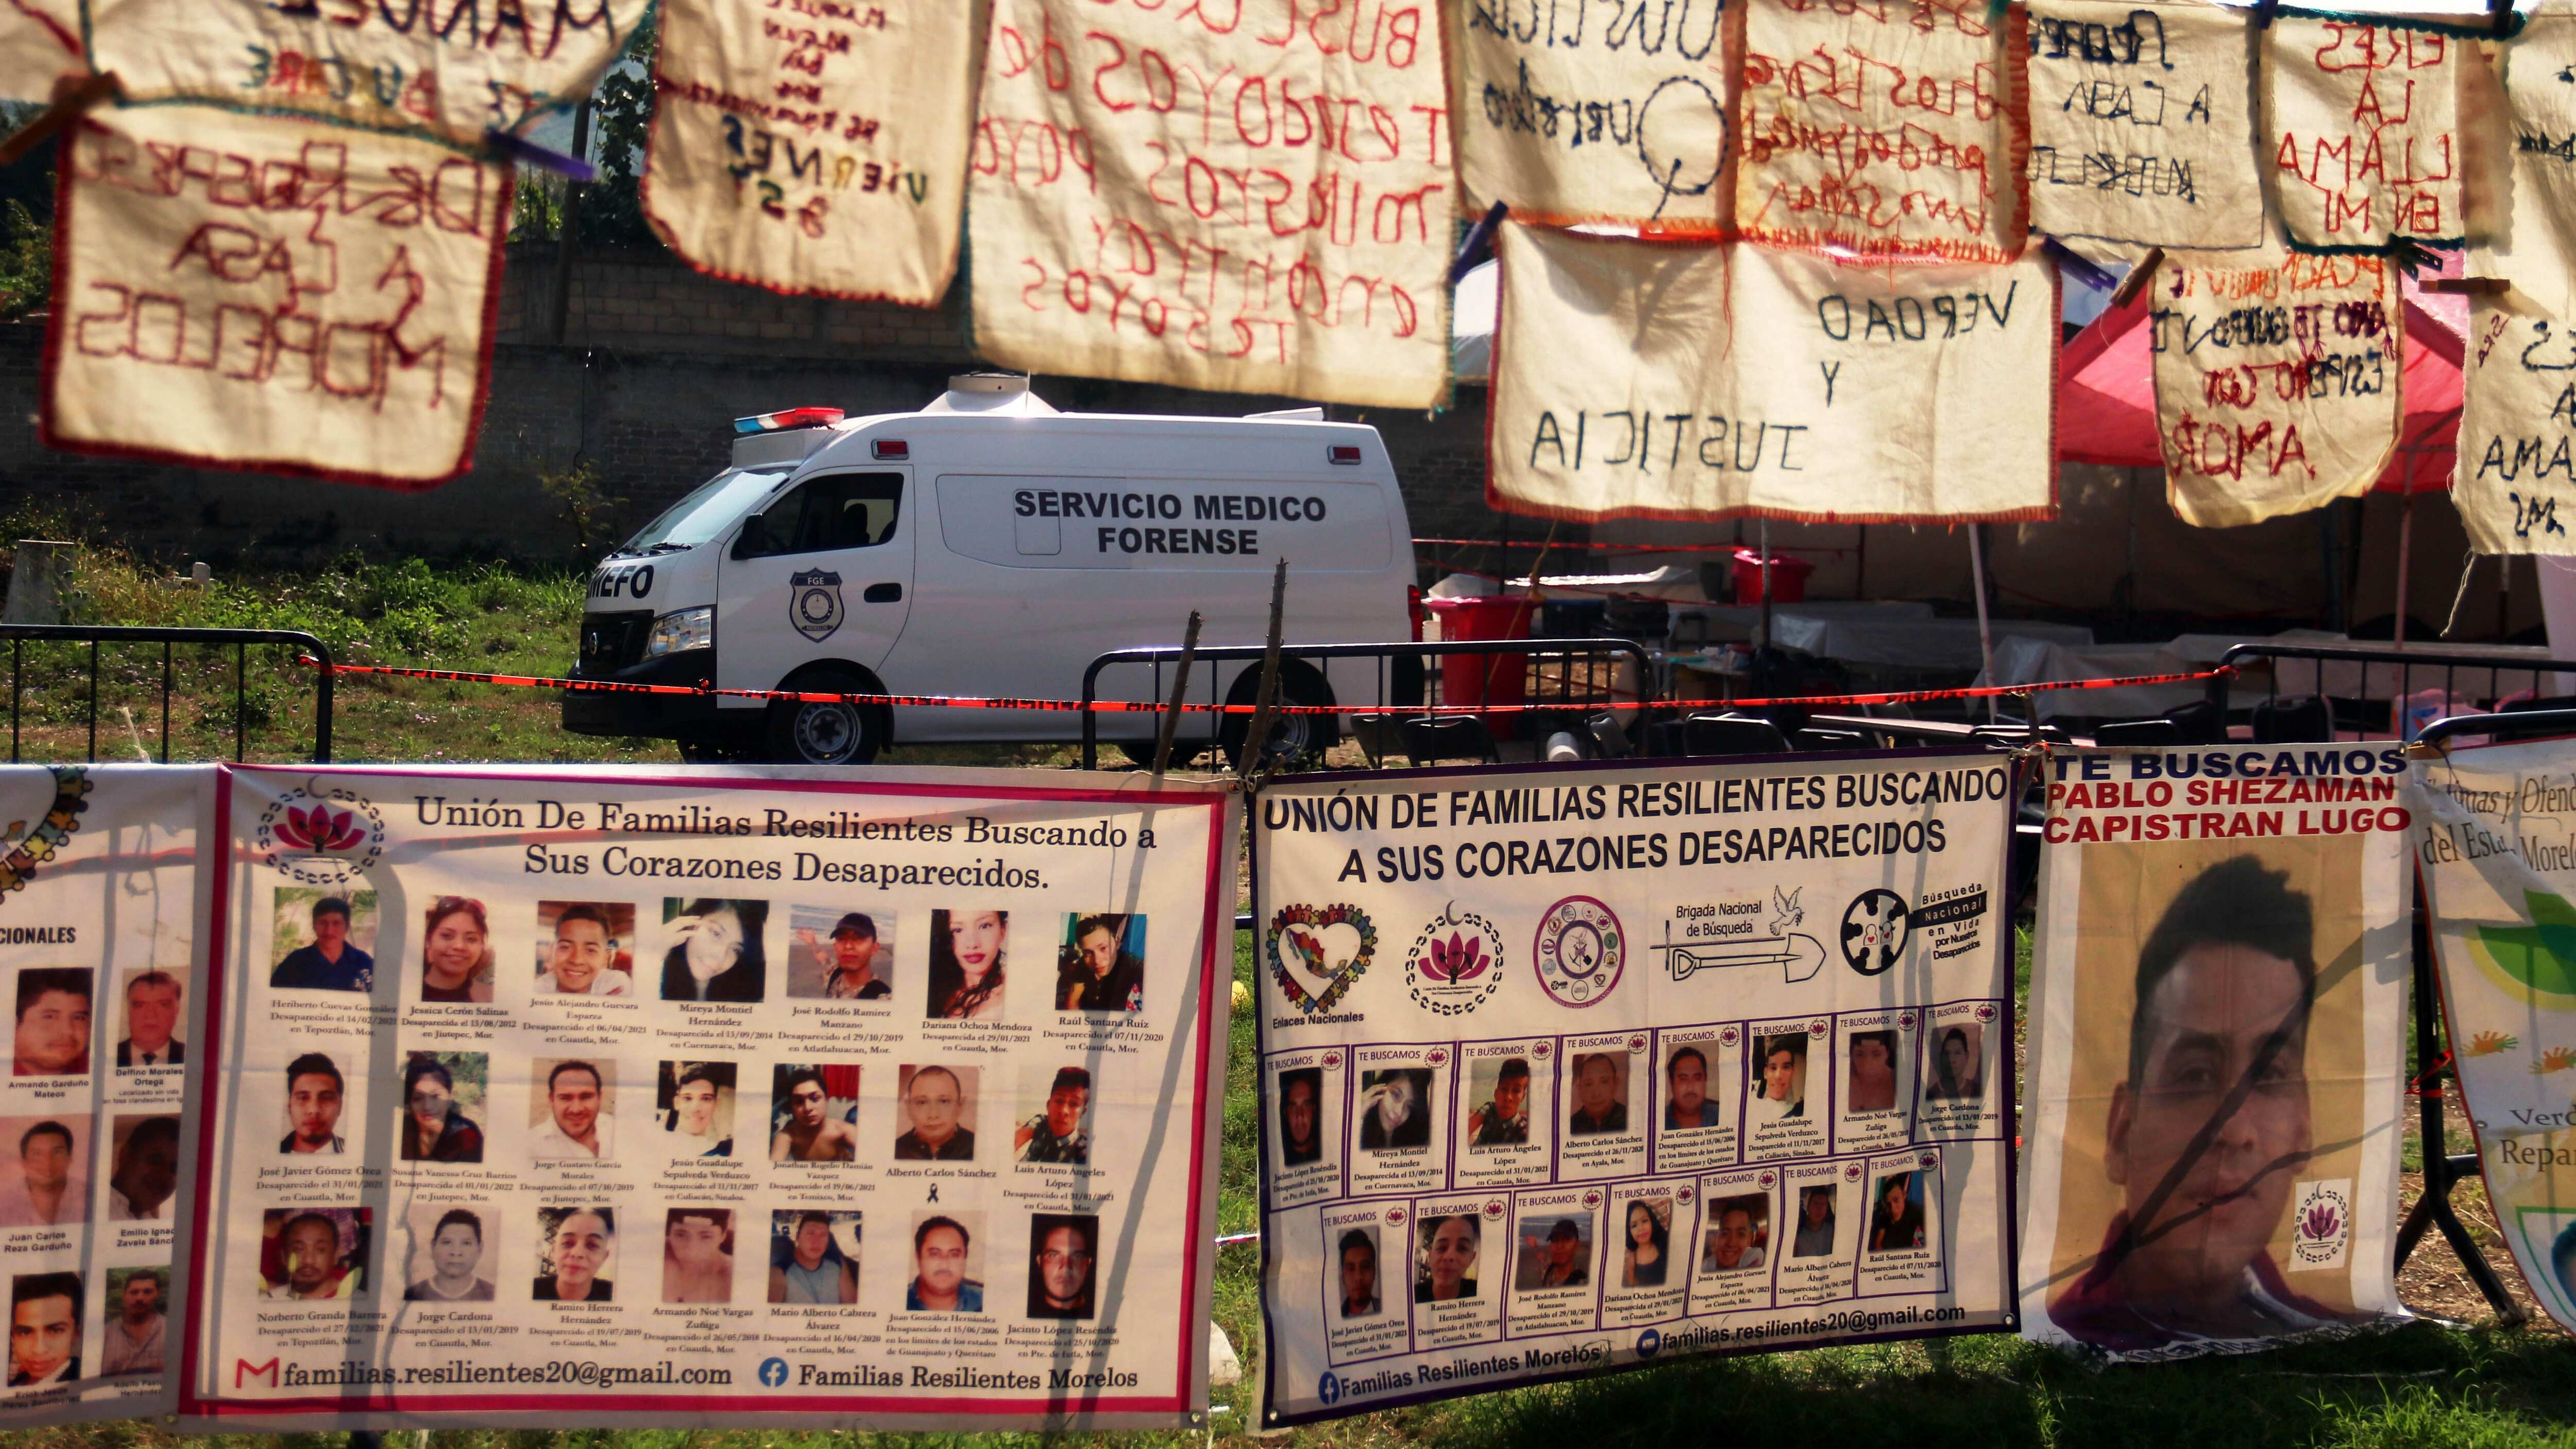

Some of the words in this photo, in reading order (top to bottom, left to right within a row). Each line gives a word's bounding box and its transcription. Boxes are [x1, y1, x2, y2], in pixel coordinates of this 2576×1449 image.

[1014, 490, 1182, 519] SERVICIO
[1194, 495, 1326, 522] MEDICO
[1098, 527, 1258, 555] FORENSE
[808, 577, 825, 585] FGE
[2055, 755, 2111, 781] TE
[2131, 748, 2408, 780] BUSCAMOS
[1264, 788, 1378, 832] UNIÓN
[1392, 792, 1438, 829] DE
[1450, 785, 1606, 826] FAMILIAS
[1617, 775, 1826, 818] RESILIENTES
[1836, 768, 2008, 808] BUSCANDO
[2048, 780, 2174, 810] PABLO
[2186, 776, 2394, 806] SHEZAMAN
[415, 796, 524, 828] Unión
[537, 799, 584, 830] De
[598, 803, 751, 838] Familias
[763, 808, 953, 843] Resilientes
[964, 816, 1127, 848] Buscando
[1137, 829, 1157, 849] a
[2043, 811, 2284, 844] CAPISTRAN
[2298, 806, 2412, 835] LUGO
[1337, 849, 1367, 883] A
[1378, 844, 1444, 883] SUS
[1456, 833, 1668, 878] CORAZONES
[1679, 819, 1946, 866] DESAPARECIDOS
[2424, 824, 2460, 865] del
[525, 843, 589, 875] Sus
[602, 846, 782, 882] Corazones
[792, 851, 1049, 890] Desaparecidos.
[1922, 883, 1982, 905] Búsqueda
[1675, 904, 1715, 919] Brigada
[1719, 900, 1762, 916] Nacional
[1925, 897, 1981, 922] Nacional
[1686, 924, 1701, 937] de
[1703, 920, 1753, 937] Búsqueda
[1928, 927, 1944, 936] en
[1954, 918, 1979, 932] Vida
[1936, 937, 1950, 949] por
[1273, 1016, 1306, 1029] Enlaces
[1308, 1012, 1364, 1026] Nacionales
[1753, 1026, 1761, 1035] TE
[1762, 1022, 1805, 1033] BUSCAMOS
[1839, 1019, 1848, 1028] TE
[1849, 1016, 1890, 1027] BUSCAMOS
[1566, 1039, 1576, 1048] TE
[1578, 1036, 1623, 1047] BUSCAMOS
[1661, 1034, 1670, 1044] TE
[1672, 1031, 1715, 1043] BUSCAMOS
[1359, 1052, 1368, 1061] TE
[1370, 1050, 1420, 1060] BUSCAMOS
[1465, 1048, 1476, 1056] TE
[1477, 1046, 1525, 1056] BUSCAMOS
[9, 1081, 48, 1089] Armando
[886, 1168, 923, 1178] Alberto
[1517, 1198, 1527, 1206] TE
[1529, 1195, 1577, 1206] BUSCAMOS
[1614, 1190, 1623, 1200] TE
[1625, 1187, 1670, 1199] BUSCAMOS
[1419, 1207, 1429, 1216] TE
[1431, 1203, 1478, 1215] BUSCAMOS
[448, 1311, 493, 1322] Cardona
[1663, 1305, 1965, 1352] familias.resilientes20@gmail.com
[284, 1360, 732, 1389] familias.resilientes20@gmail.com
[799, 1364, 903, 1387] Familias
[911, 1365, 1041, 1390] Resilientes
[1047, 1368, 1138, 1390] Morelos
[1341, 1370, 1413, 1397] Familias
[1417, 1353, 1520, 1383] Resilientes
[1524, 1345, 1601, 1369] Morelos
